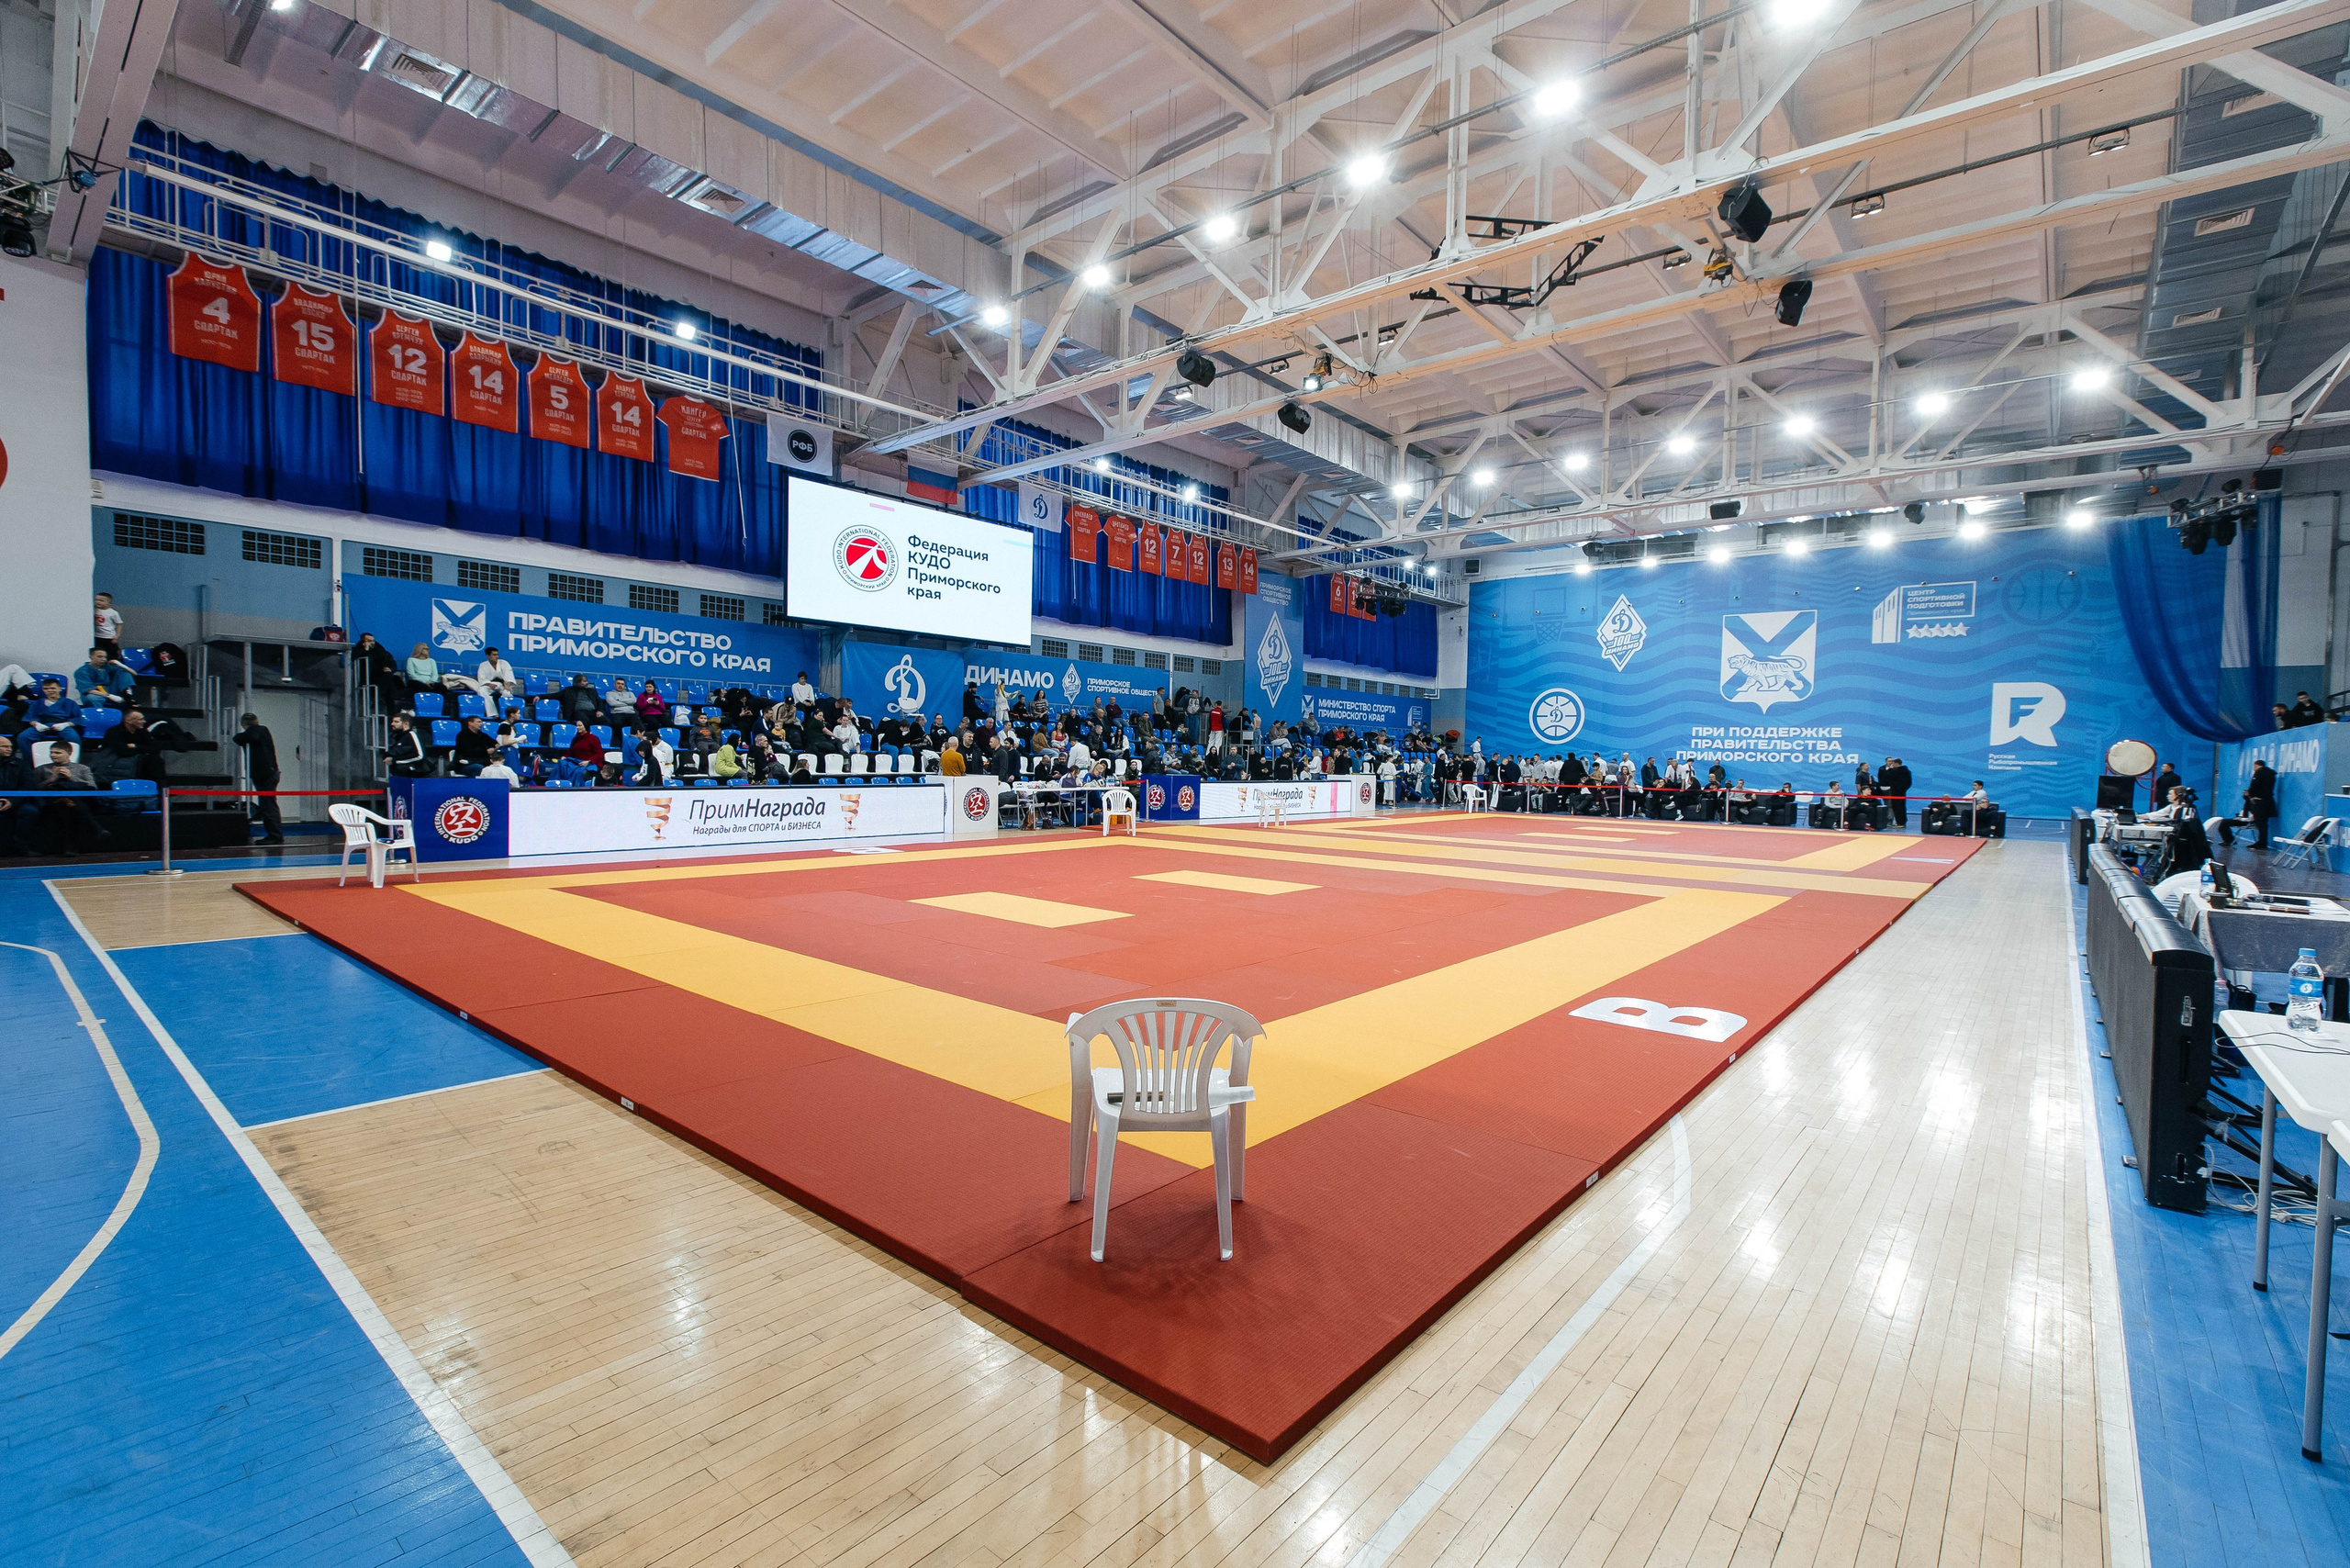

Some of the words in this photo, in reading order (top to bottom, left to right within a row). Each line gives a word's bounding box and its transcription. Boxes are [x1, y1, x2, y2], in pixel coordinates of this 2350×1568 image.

[202, 297, 230, 325] 4
[194, 320, 239, 340] СПАРТАК
[291, 319, 335, 352] 15
[295, 347, 335, 364] СПАРТАК
[387, 343, 428, 375] 12
[391, 370, 427, 386] СПАРТАК
[468, 364, 504, 395] 14
[470, 389, 502, 405] СПАРТАК
[550, 386, 569, 410] 5
[544, 409, 575, 422] СПАРТАК
[610, 401, 642, 428] 14
[611, 423, 641, 437] СПАРТАК
[681, 427, 707, 440] СПАРТАК
[792, 440, 813, 453] РФБ
[837, 528, 880, 549] INTERNATIONAL
[1144, 538, 1157, 554] 12
[908, 534, 989, 561] Федерация
[1172, 545, 1180, 559] 7
[836, 549, 845, 569] KUDO
[881, 538, 896, 577] FEDERATION
[909, 551, 951, 570] КУДО
[1192, 551, 1204, 566] 12
[1223, 557, 1233, 571] 13
[1244, 562, 1254, 576] 14
[908, 566, 1001, 594] Приморского
[1259, 581, 1292, 594] ПРИМОРСКОЕ
[908, 586, 941, 599] края
[1259, 588, 1292, 600] СПОРТИВНОЕ
[1336, 586, 1340, 597] 6
[1908, 593, 1965, 602] СПОРТИВНОЙ
[1263, 596, 1289, 606] ОБЩЕСТВО
[1908, 600, 1964, 609] ПОДГОТОВКИ
[509, 611, 732, 650] ПРАВИТЕЛЬСТВО
[509, 633, 706, 666] ПРИМОРСКОГО
[712, 653, 770, 672] КРАЯ
[1606, 643, 1639, 655] ДИНАМО
[964, 665, 1054, 689] ДИНАМО
[1087, 678, 1130, 688] ПРИМОРСКОЕ
[1263, 673, 1286, 685] ДИНАМО
[1087, 685, 1129, 695] СПОРТИВНОЕ
[1131, 689, 1158, 697] ОБЩЕСТ
[1318, 699, 1371, 711] МИНИСТЕРСТВО
[1372, 702, 1395, 714] СПОРТА
[1318, 709, 1367, 722] ПРИМОРСКОГО
[1368, 713, 1385, 722] КРАЯ
[1692, 727, 1724, 737] ПРИ
[1729, 727, 1842, 738] ПОДДЕРЖКЕ
[1691, 739, 1841, 750] ПРАВИТЕЛЬСТВА
[1676, 751, 1804, 763] ПРИМОРСКОГО
[1808, 753, 1859, 764] КРАЯ
[434, 796, 466, 835] INTERNATIONAL
[468, 797, 490, 832] FEDERATION
[688, 796, 826, 824] ПримНаграда
[693, 824, 731, 836] Награды
[732, 823, 746, 834] для
[748, 823, 780, 833] СПОРТА
[788, 821, 822, 831] БИЗНЕСА
[448, 834, 478, 844] KUDO
[1568, 996, 1748, 1043] B
